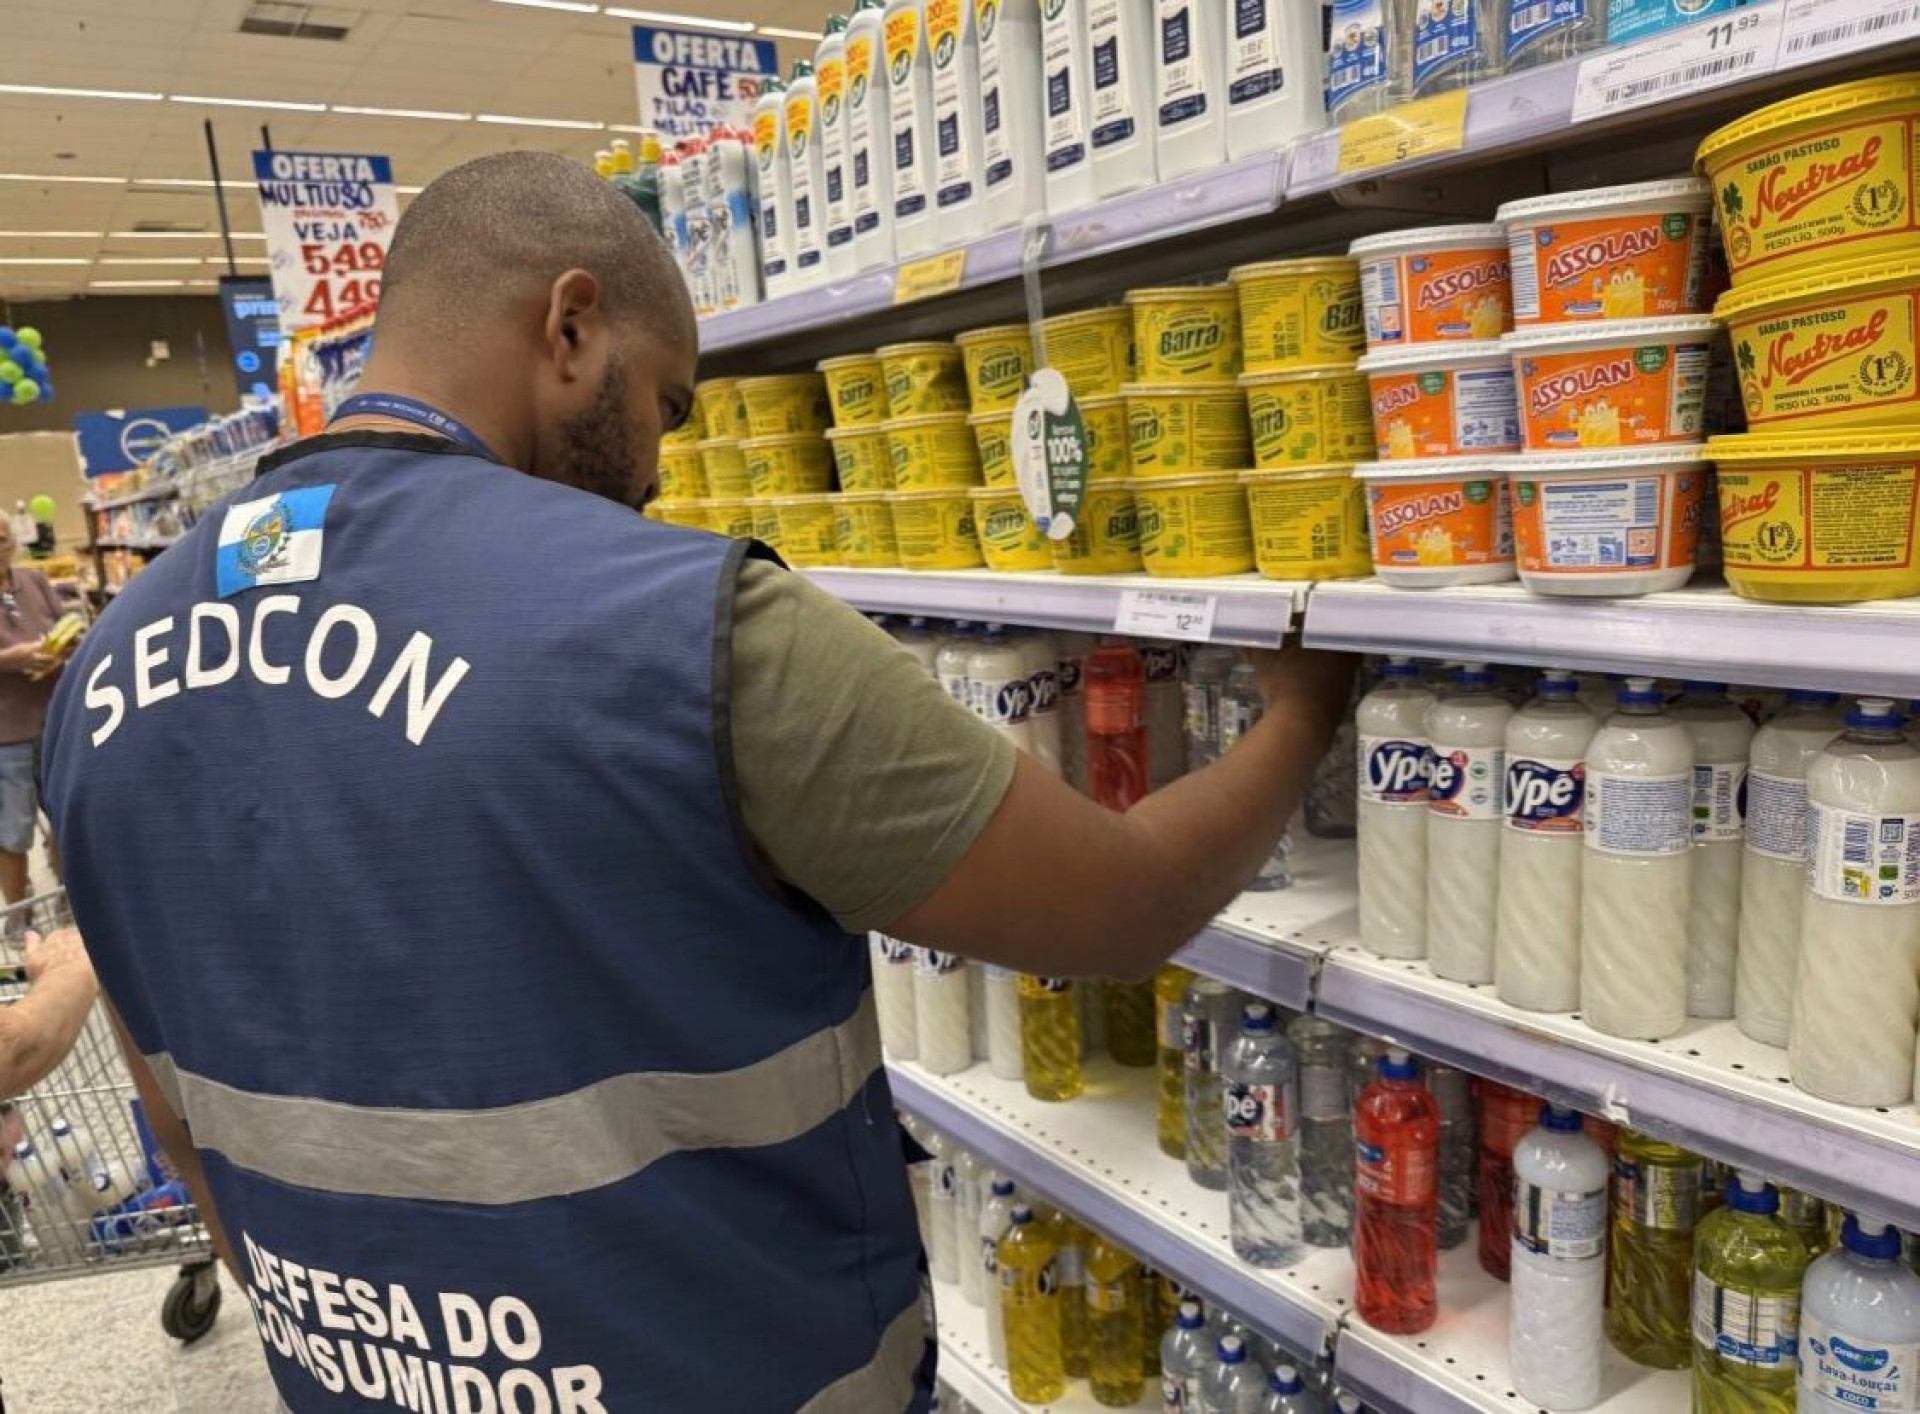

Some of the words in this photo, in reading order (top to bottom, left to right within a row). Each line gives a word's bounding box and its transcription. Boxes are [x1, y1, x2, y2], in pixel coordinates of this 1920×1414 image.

[652, 32, 761, 71] OFERTA
[271, 155, 376, 182] OFERTA
[1783, 137, 1841, 162] PASTOSO
[259, 180, 375, 209] MULTIUSO
[1750, 136, 1882, 230] Neutral
[294, 221, 359, 241] VEJA
[1547, 228, 1660, 287] ASSOLAN
[1791, 309, 1846, 330] PASTOSO
[1160, 324, 1219, 356] Barra
[1761, 308, 1888, 389] Neutral
[1532, 360, 1632, 413] ASSOLAN
[85, 595, 471, 748] SEDCON
[242, 1230, 431, 1351] DEFESA
[438, 1291, 542, 1362] DO
